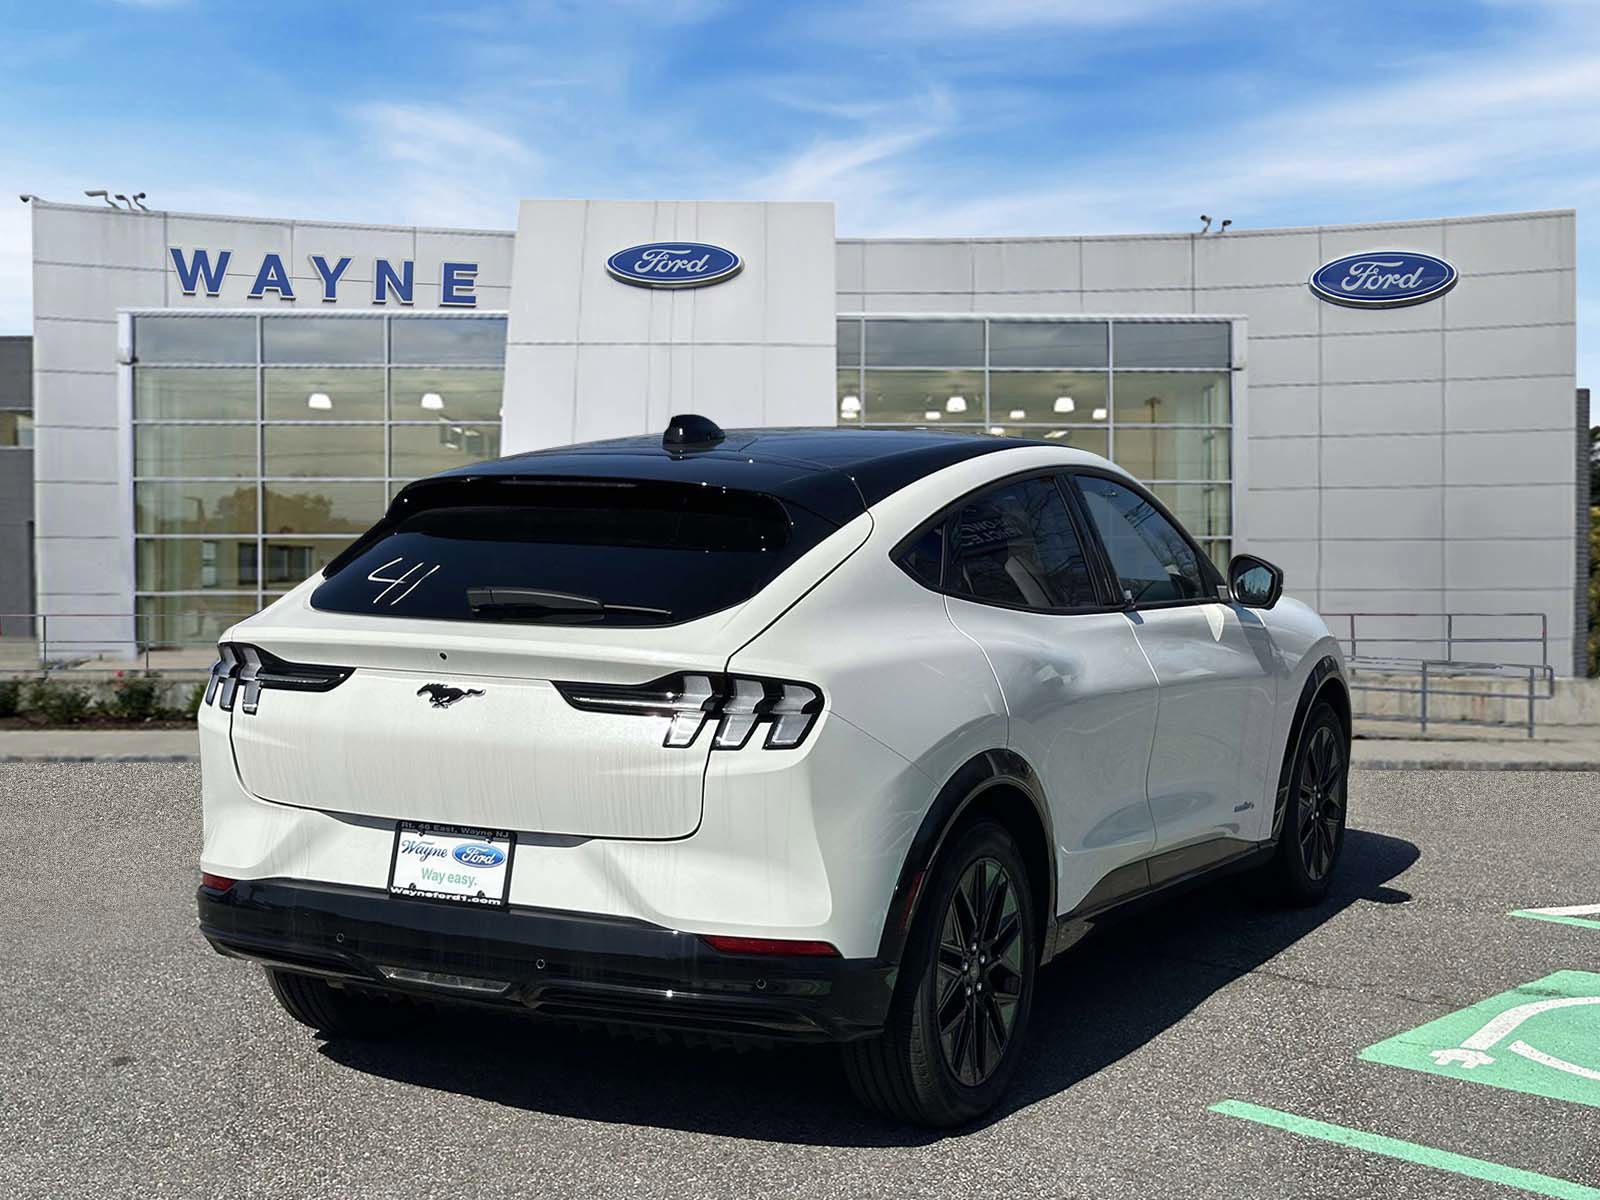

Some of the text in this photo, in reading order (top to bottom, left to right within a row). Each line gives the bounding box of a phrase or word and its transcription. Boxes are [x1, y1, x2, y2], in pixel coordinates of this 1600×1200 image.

[634, 248, 711, 273] Ford
[170, 247, 479, 306] WAYNE
[1341, 260, 1425, 291] Ford
[367, 557, 441, 606] 41
[460, 827, 494, 837] Wayne
[495, 830, 510, 839] NJ
[401, 840, 496, 865] Wayne Ford
[421, 867, 478, 889] Way easy.
[390, 886, 501, 906] Wayneford1.com
